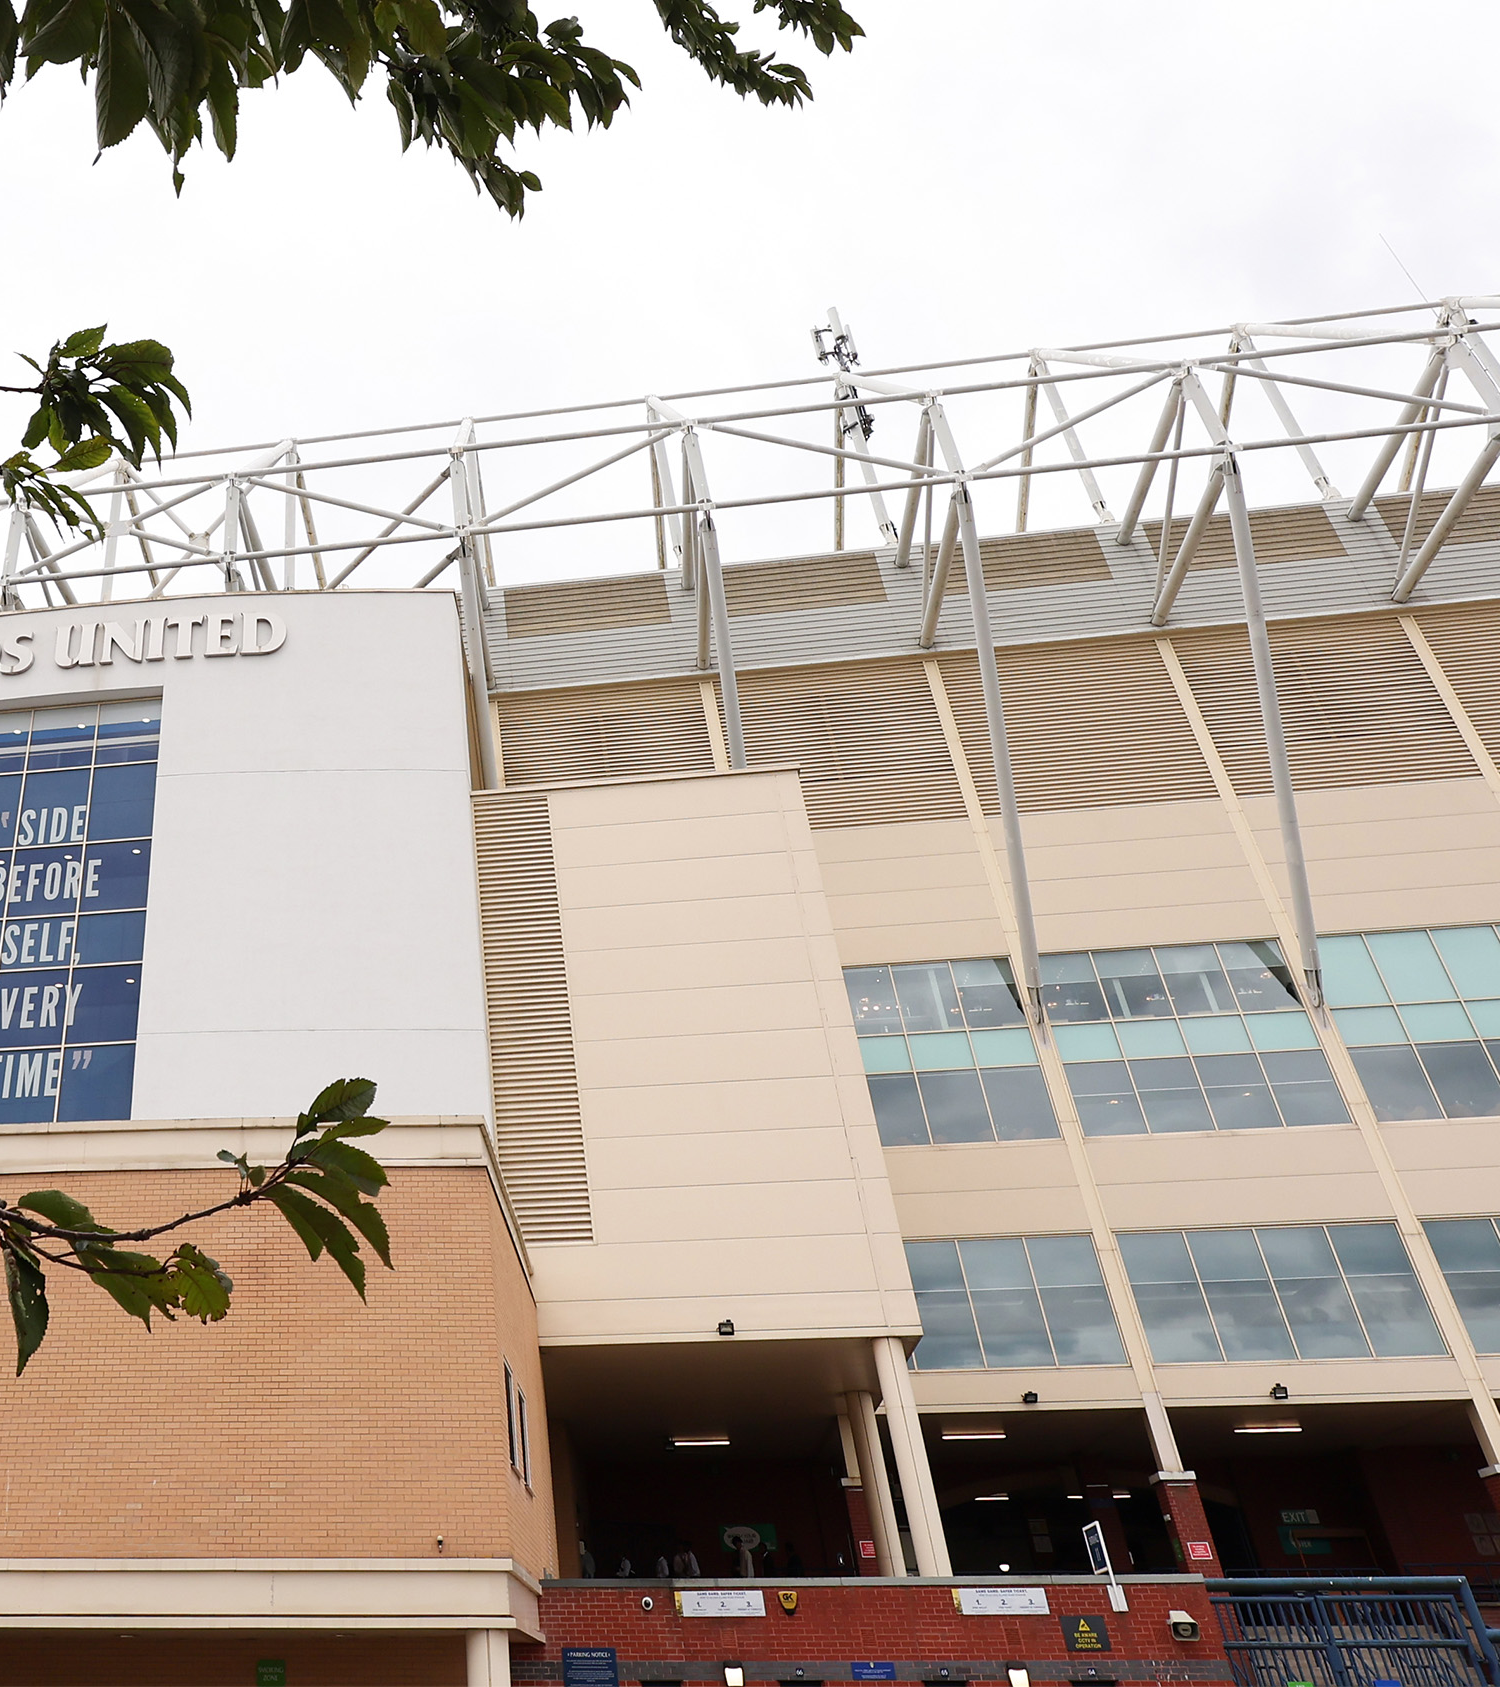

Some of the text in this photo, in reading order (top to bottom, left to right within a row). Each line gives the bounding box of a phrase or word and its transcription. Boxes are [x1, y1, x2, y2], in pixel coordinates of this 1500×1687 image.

[54, 612, 288, 670] UNITED
[0, 921, 81, 966] SELF,
[1281, 1511, 1306, 1523] EXIT
